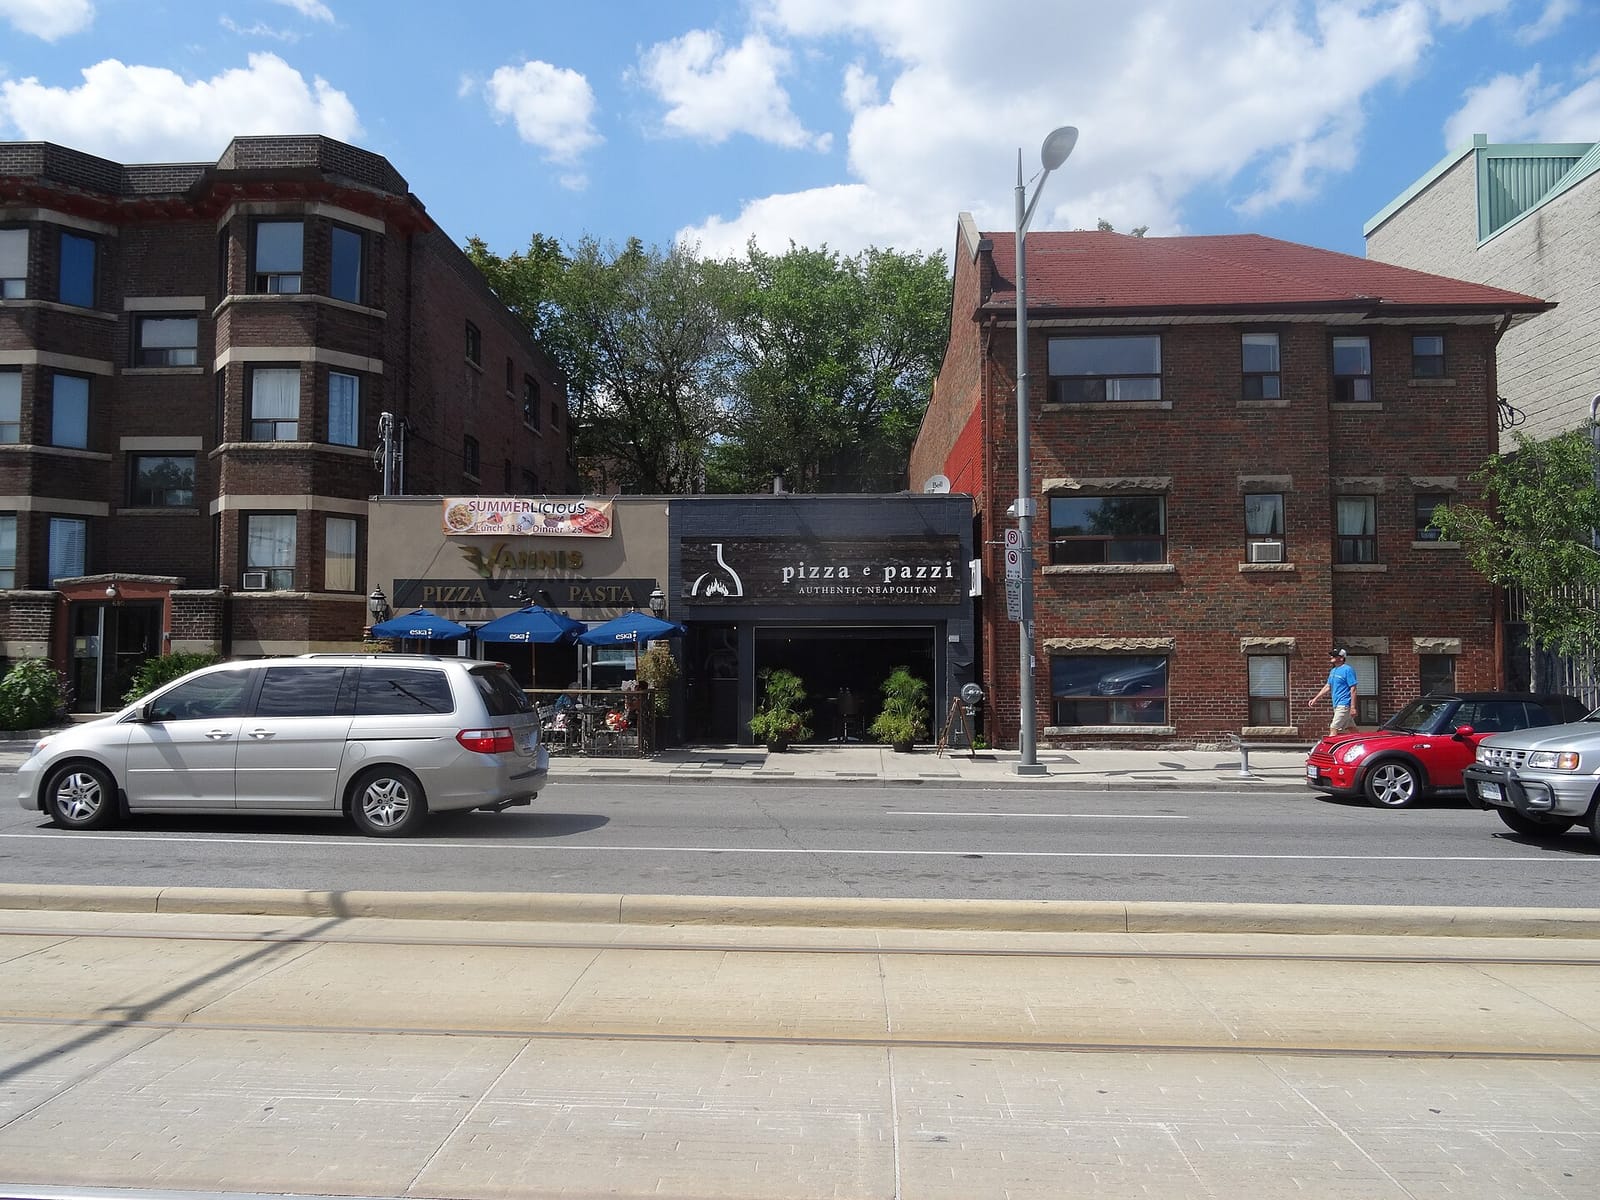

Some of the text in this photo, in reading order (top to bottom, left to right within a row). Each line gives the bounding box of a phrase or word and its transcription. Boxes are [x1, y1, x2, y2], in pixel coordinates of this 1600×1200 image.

[468, 501, 585, 514] SUMMERLICIOUS
[476, 524, 503, 532] Lunch
[532, 525, 563, 534] Dinner
[782, 561, 953, 583] pizza e pazzi
[423, 585, 635, 603] PIZZA PASTA
[799, 586, 937, 594] AUTHENTIC NEAPOLITAN
